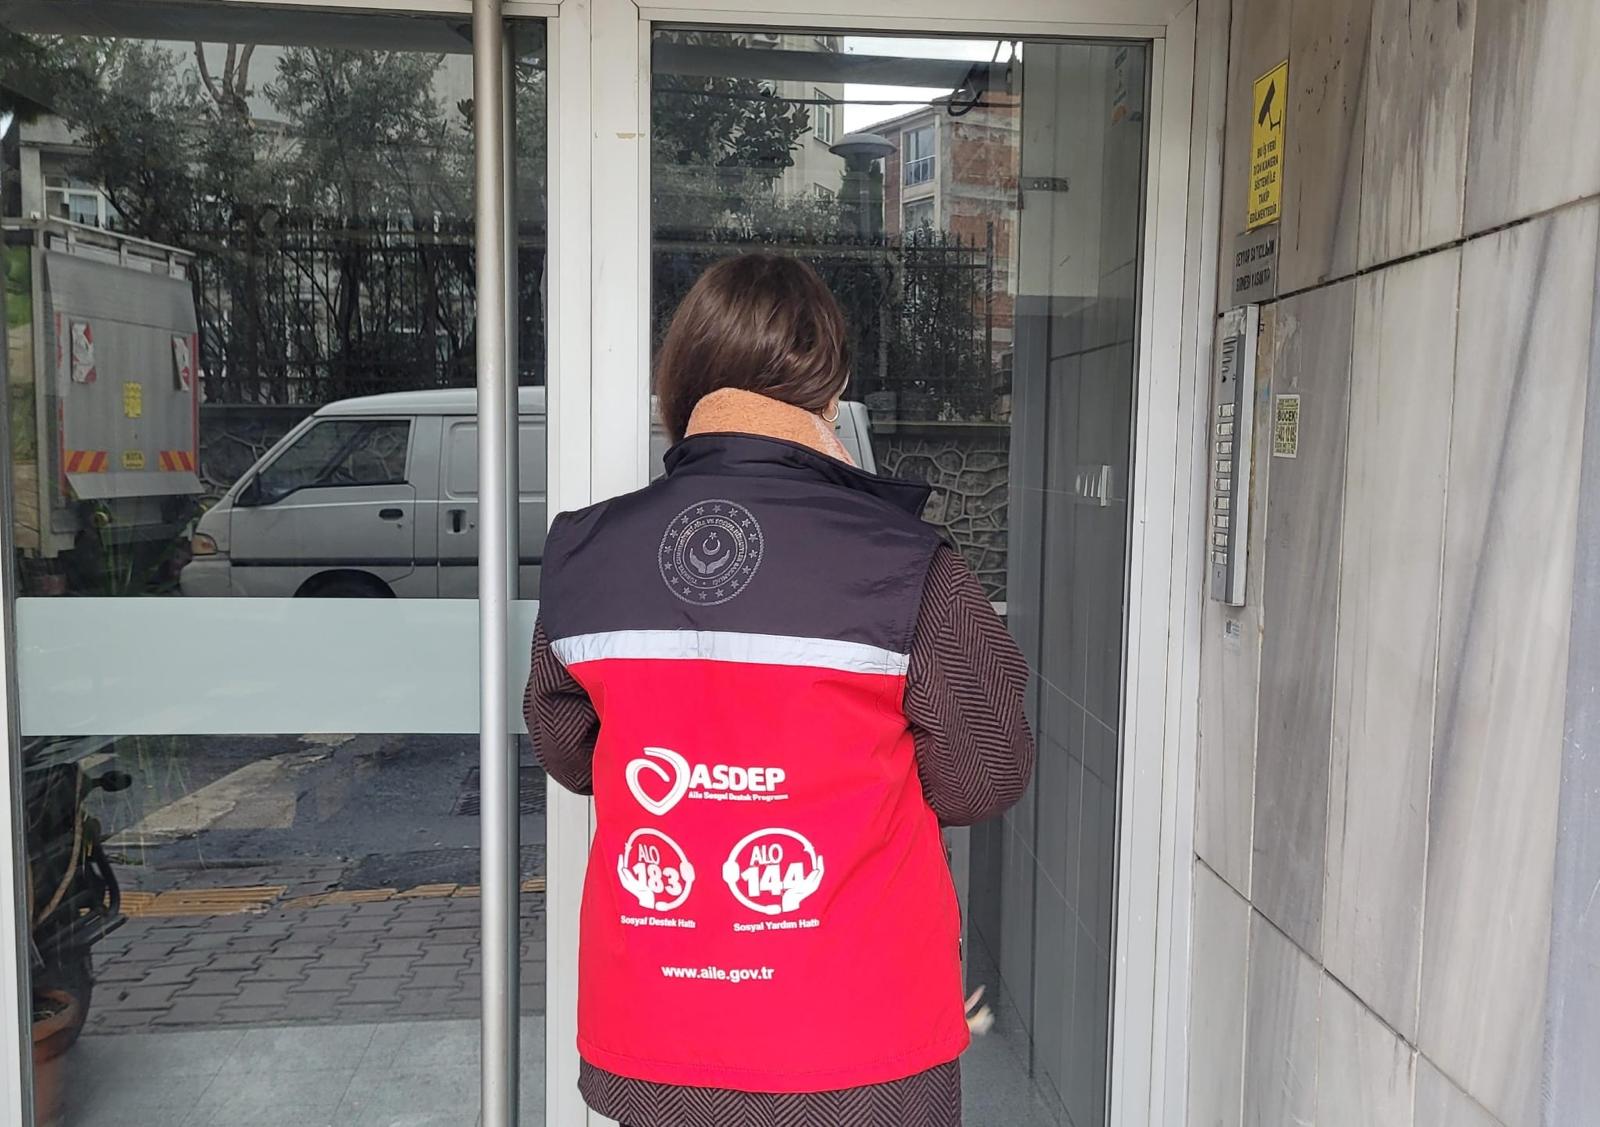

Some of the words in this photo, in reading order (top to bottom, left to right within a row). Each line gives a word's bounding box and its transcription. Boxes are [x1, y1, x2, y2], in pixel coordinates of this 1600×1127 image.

[1262, 154, 1279, 171] KAMERA
[688, 763, 785, 792] ASDEP
[638, 843, 660, 864] ALO
[750, 843, 783, 866] ALO
[632, 862, 683, 896] 183
[740, 862, 806, 898] 144
[620, 915, 648, 927] Sosyal
[648, 916, 677, 927] Destek
[733, 922, 764, 933] Sosyal
[765, 920, 798, 930] Yardım
[661, 966, 775, 984] www.aile.gov.tr
